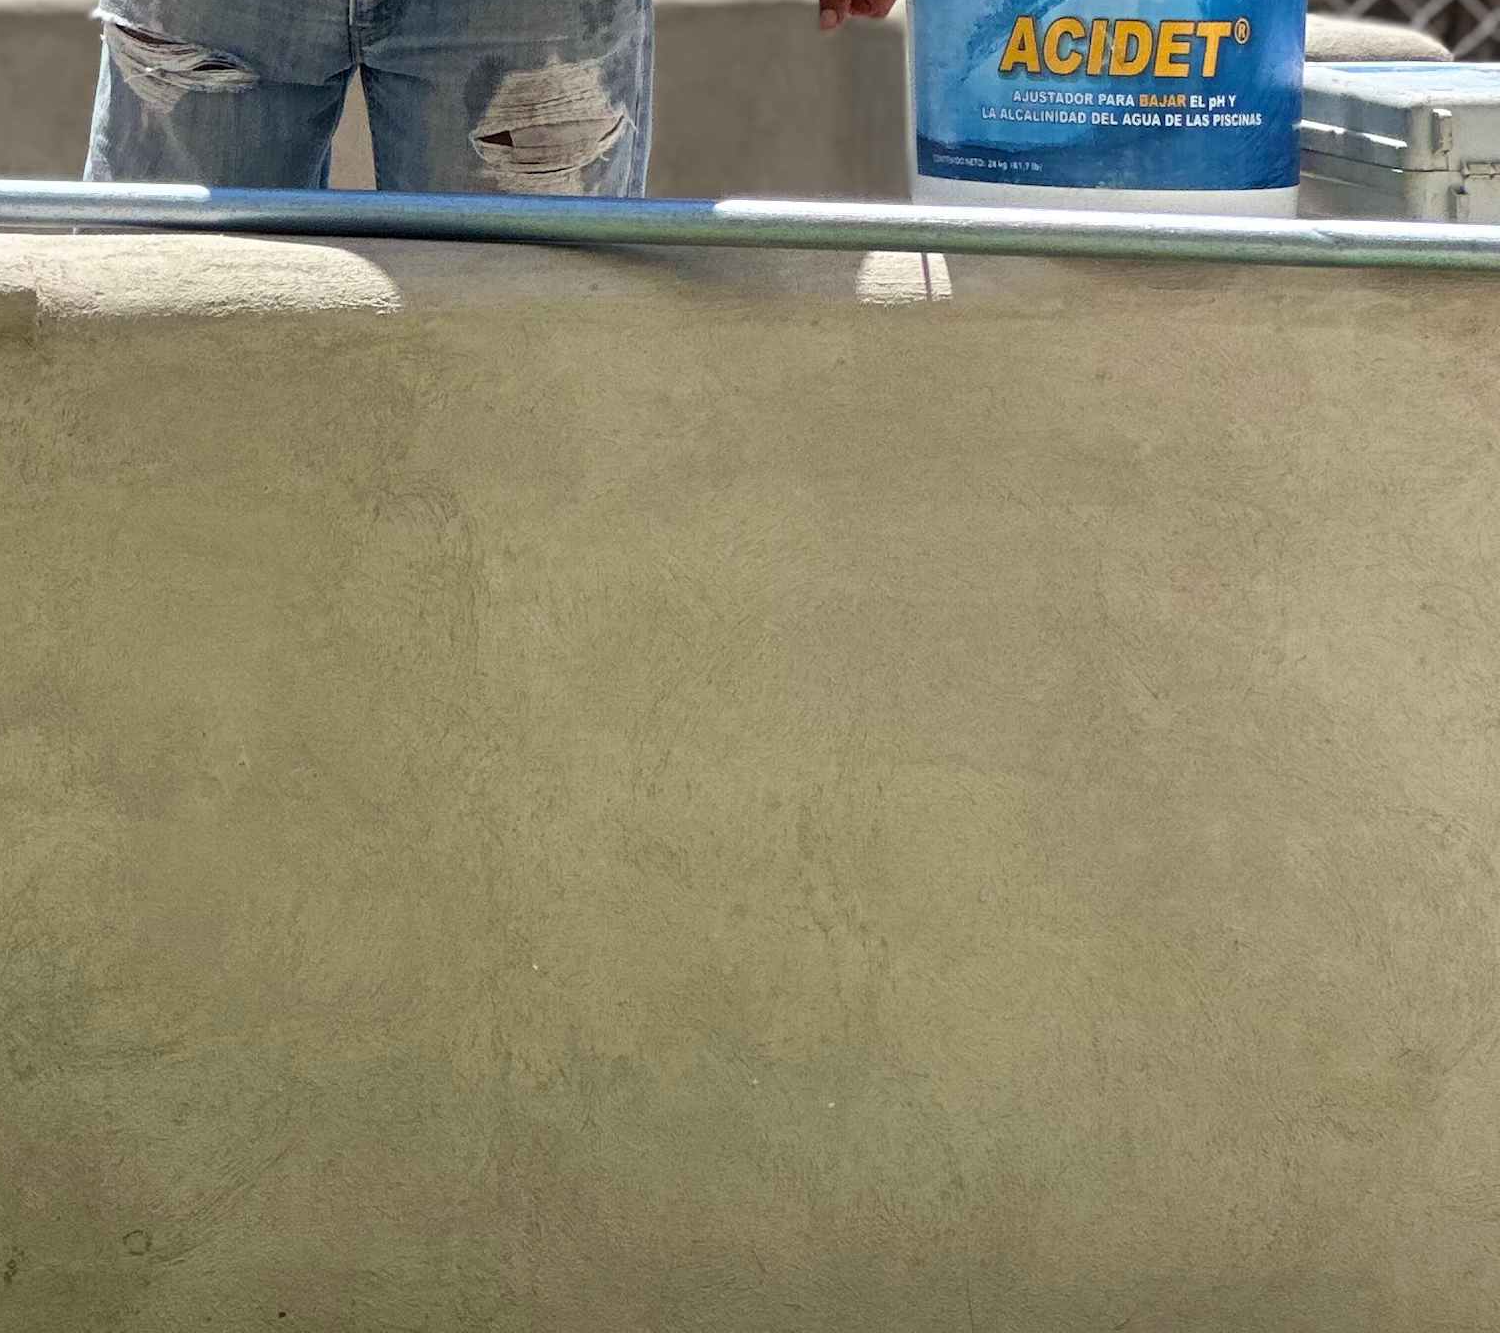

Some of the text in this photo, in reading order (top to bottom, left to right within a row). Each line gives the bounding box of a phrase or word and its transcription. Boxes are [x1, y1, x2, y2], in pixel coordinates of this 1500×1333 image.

[1013, 90, 1237, 111] AJUSTADOR PARA BAJAR EL pH Y
[982, 107, 1262, 127] LA ALCALINIDAD DEL AGUA DE LAS PISCINAS
